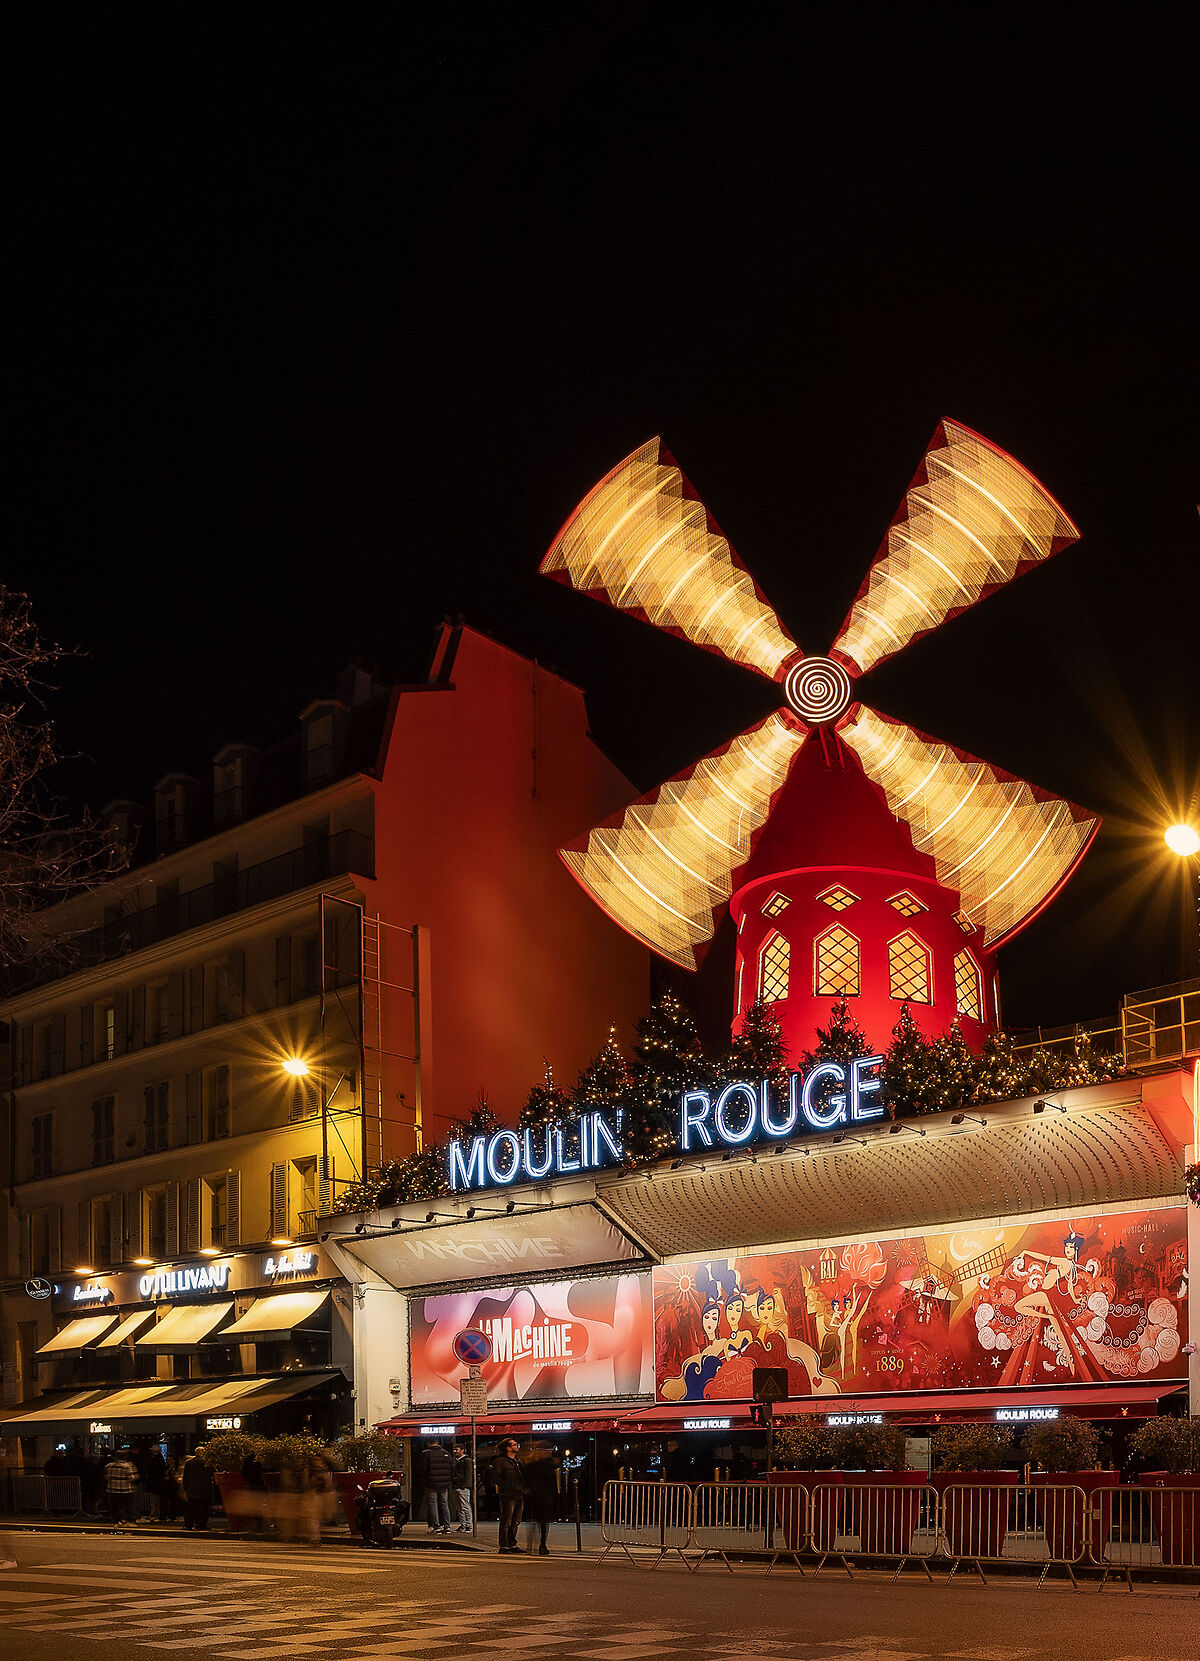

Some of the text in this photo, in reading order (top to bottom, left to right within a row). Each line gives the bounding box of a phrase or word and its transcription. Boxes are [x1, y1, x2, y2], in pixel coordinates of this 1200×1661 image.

[449, 1054, 885, 1191] MOULIN ROUGE
[820, 1259, 838, 1280] BAL
[875, 1355, 905, 1375] 1889
[827, 1414, 883, 1426] MOULIN ROUGE
[996, 1408, 1060, 1421] MOULIN ROUGE
[683, 1418, 731, 1430] MOULIN ROUGE
